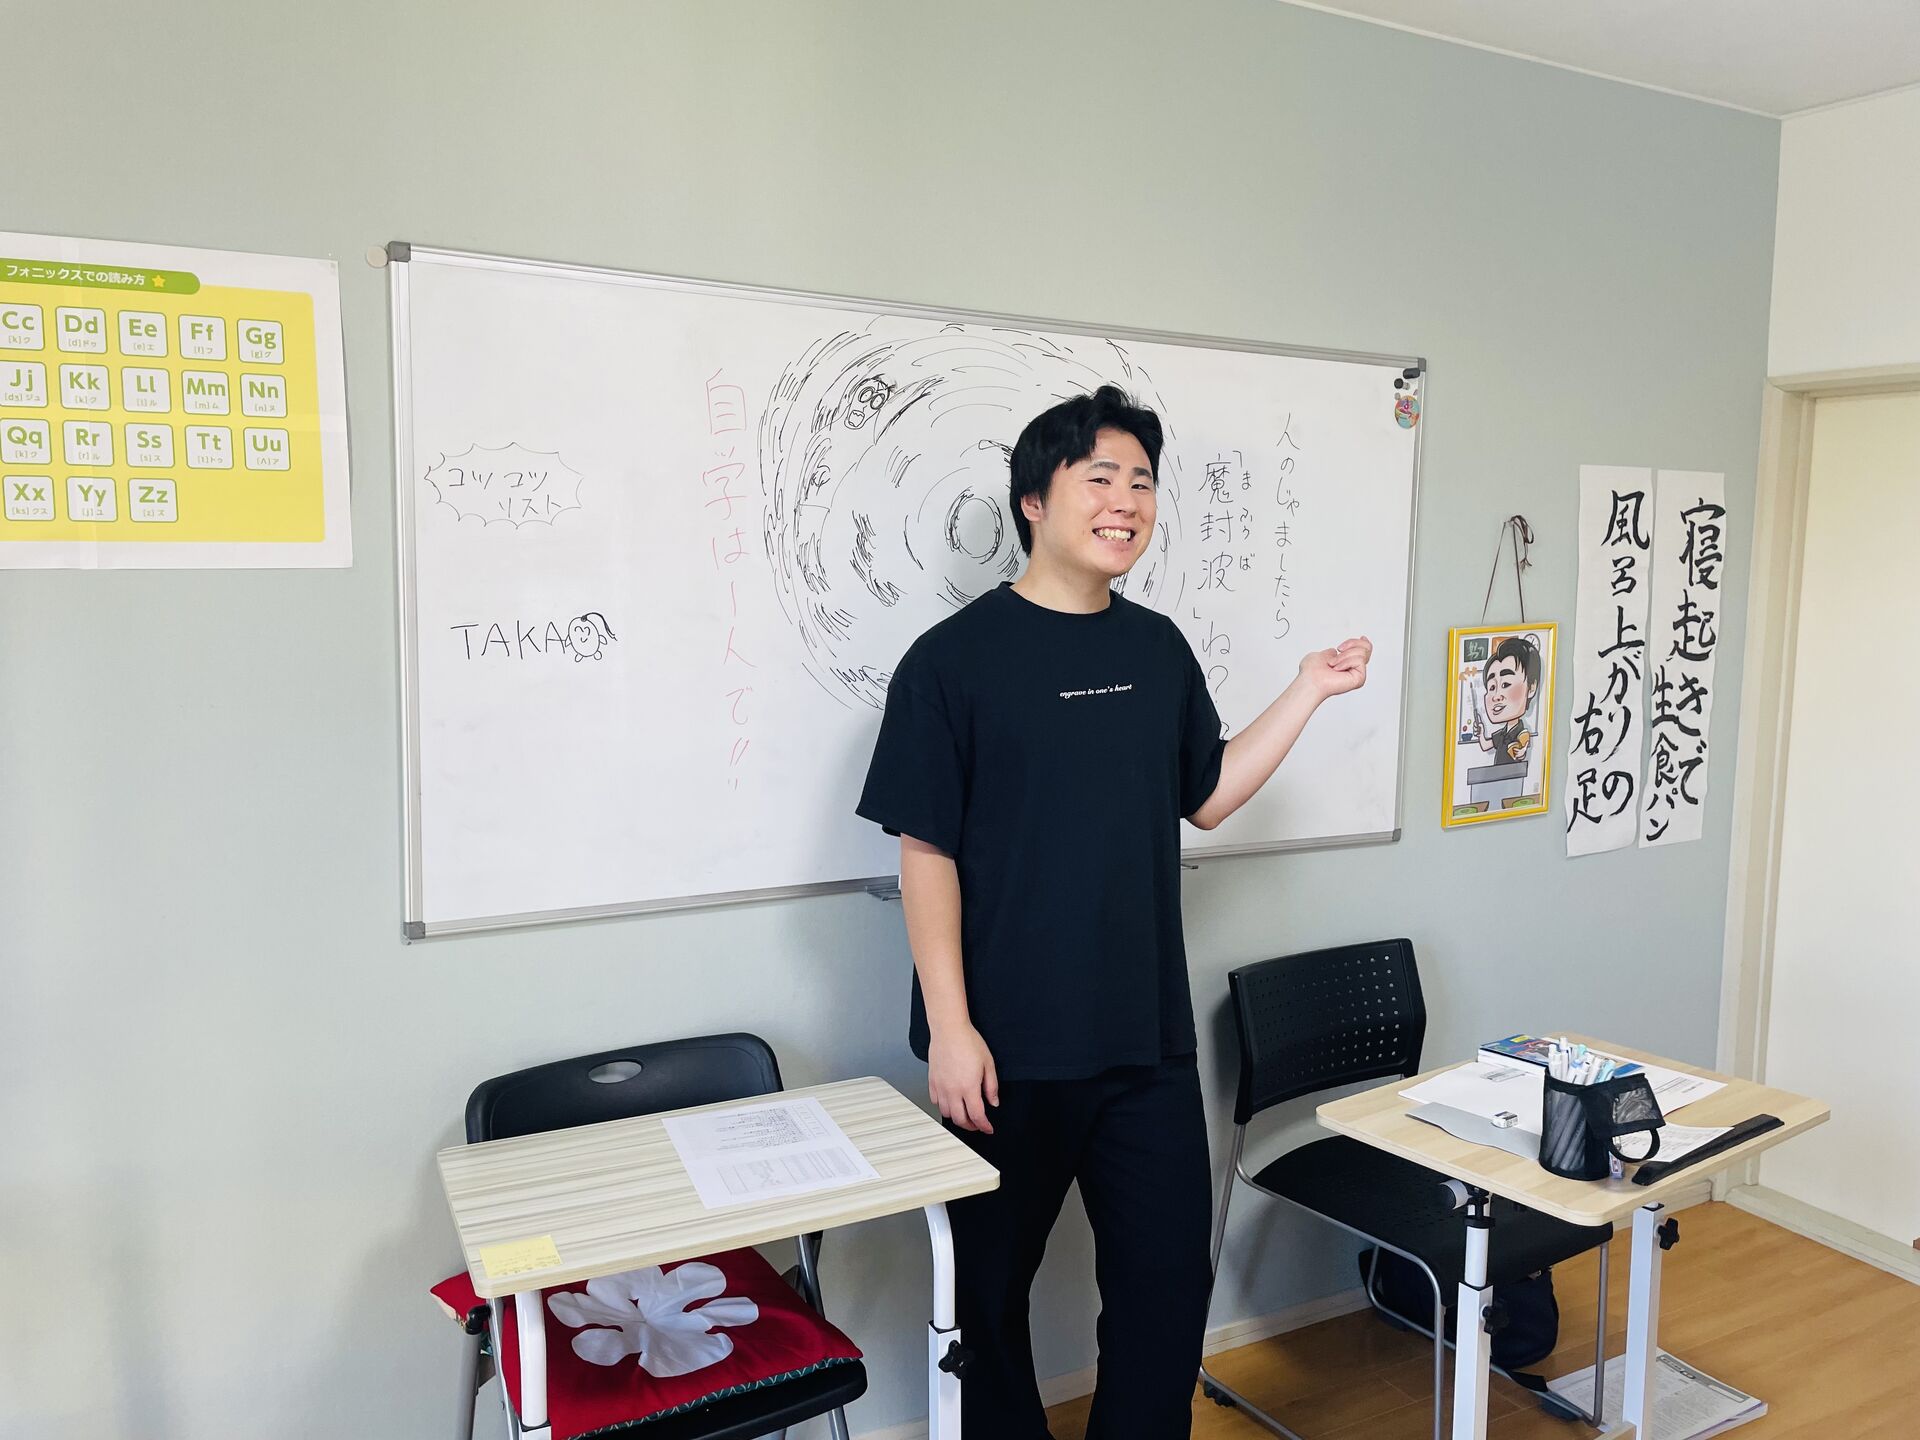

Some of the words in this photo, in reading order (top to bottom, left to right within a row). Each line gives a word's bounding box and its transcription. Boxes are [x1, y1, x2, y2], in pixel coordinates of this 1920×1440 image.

[6, 264, 146, 286] フォニックスでの読み方
[1, 310, 35, 330] Cc
[63, 314, 99, 334] Dd
[128, 318, 158, 338] Ee
[190, 322, 214, 341] Ff
[245, 326, 277, 350] Gg
[9, 368, 34, 392] Jj
[68, 371, 101, 391] Kk
[135, 374, 157, 393] Ll
[186, 377, 226, 397] Mm
[248, 381, 280, 399] Nn
[6, 426, 43, 449] Qq
[75, 428, 101, 447] Rr
[136, 430, 162, 449] Ss
[196, 432, 222, 450] Tt
[252, 434, 282, 452] Uu
[13, 482, 46, 501] Xx
[77, 484, 107, 507] Yy
[138, 485, 169, 504] Zz
[498, 493, 563, 519] リスト
[1273, 412, 1301, 640] 人のじゃましたら
[1597, 488, 1651, 818] 風呂上がりの
[1666, 497, 1727, 807] 寝起きで
[1059, 690, 1087, 700] engrave
[1087, 688, 1095, 696] in
[1095, 685, 1114, 695] one's
[1114, 683, 1133, 693] heart
[1565, 691, 1604, 835] 右足
[1645, 664, 1680, 843] 生食パン
